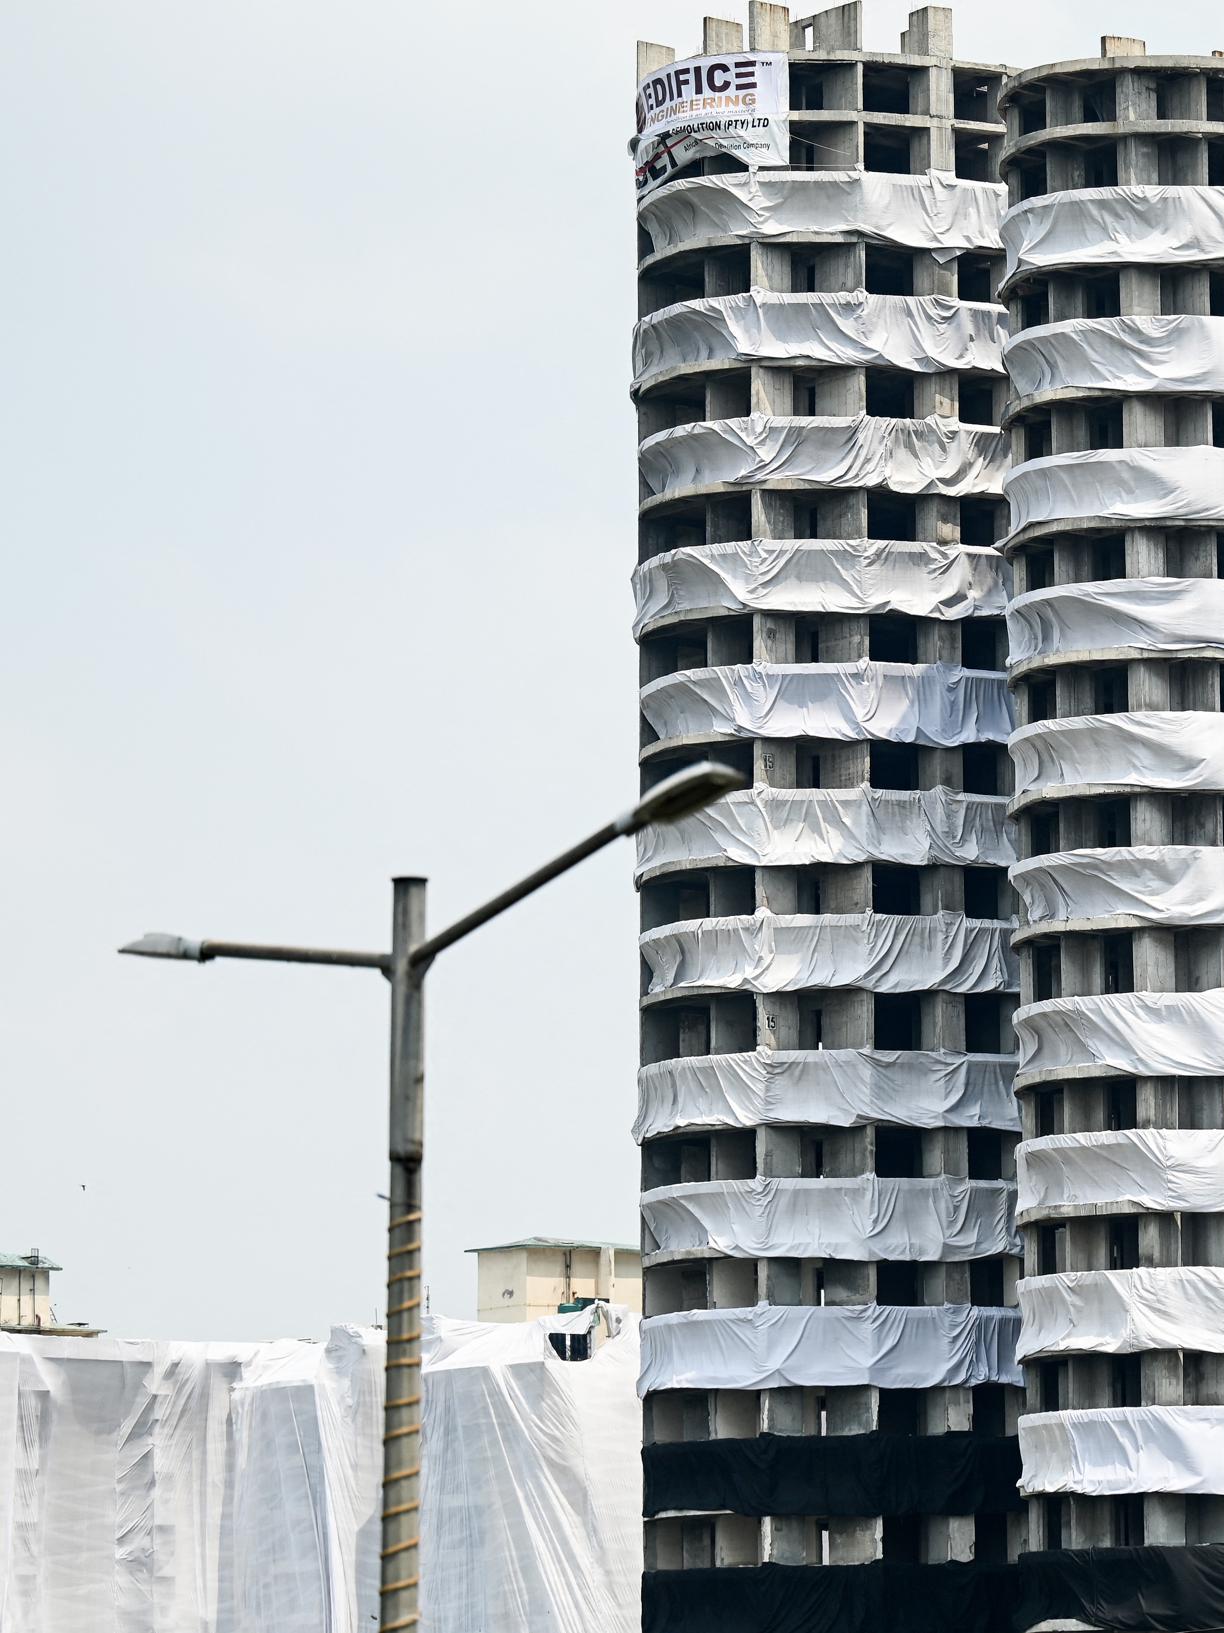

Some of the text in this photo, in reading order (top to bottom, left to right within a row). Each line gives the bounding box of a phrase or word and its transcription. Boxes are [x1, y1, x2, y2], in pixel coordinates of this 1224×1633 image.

[642, 60, 758, 113] EDIFICE
[724, 118, 749, 132] (PTY)
[752, 117, 769, 128] LTD
[743, 142, 771, 151] Company
[766, 1015, 776, 1029] 15
